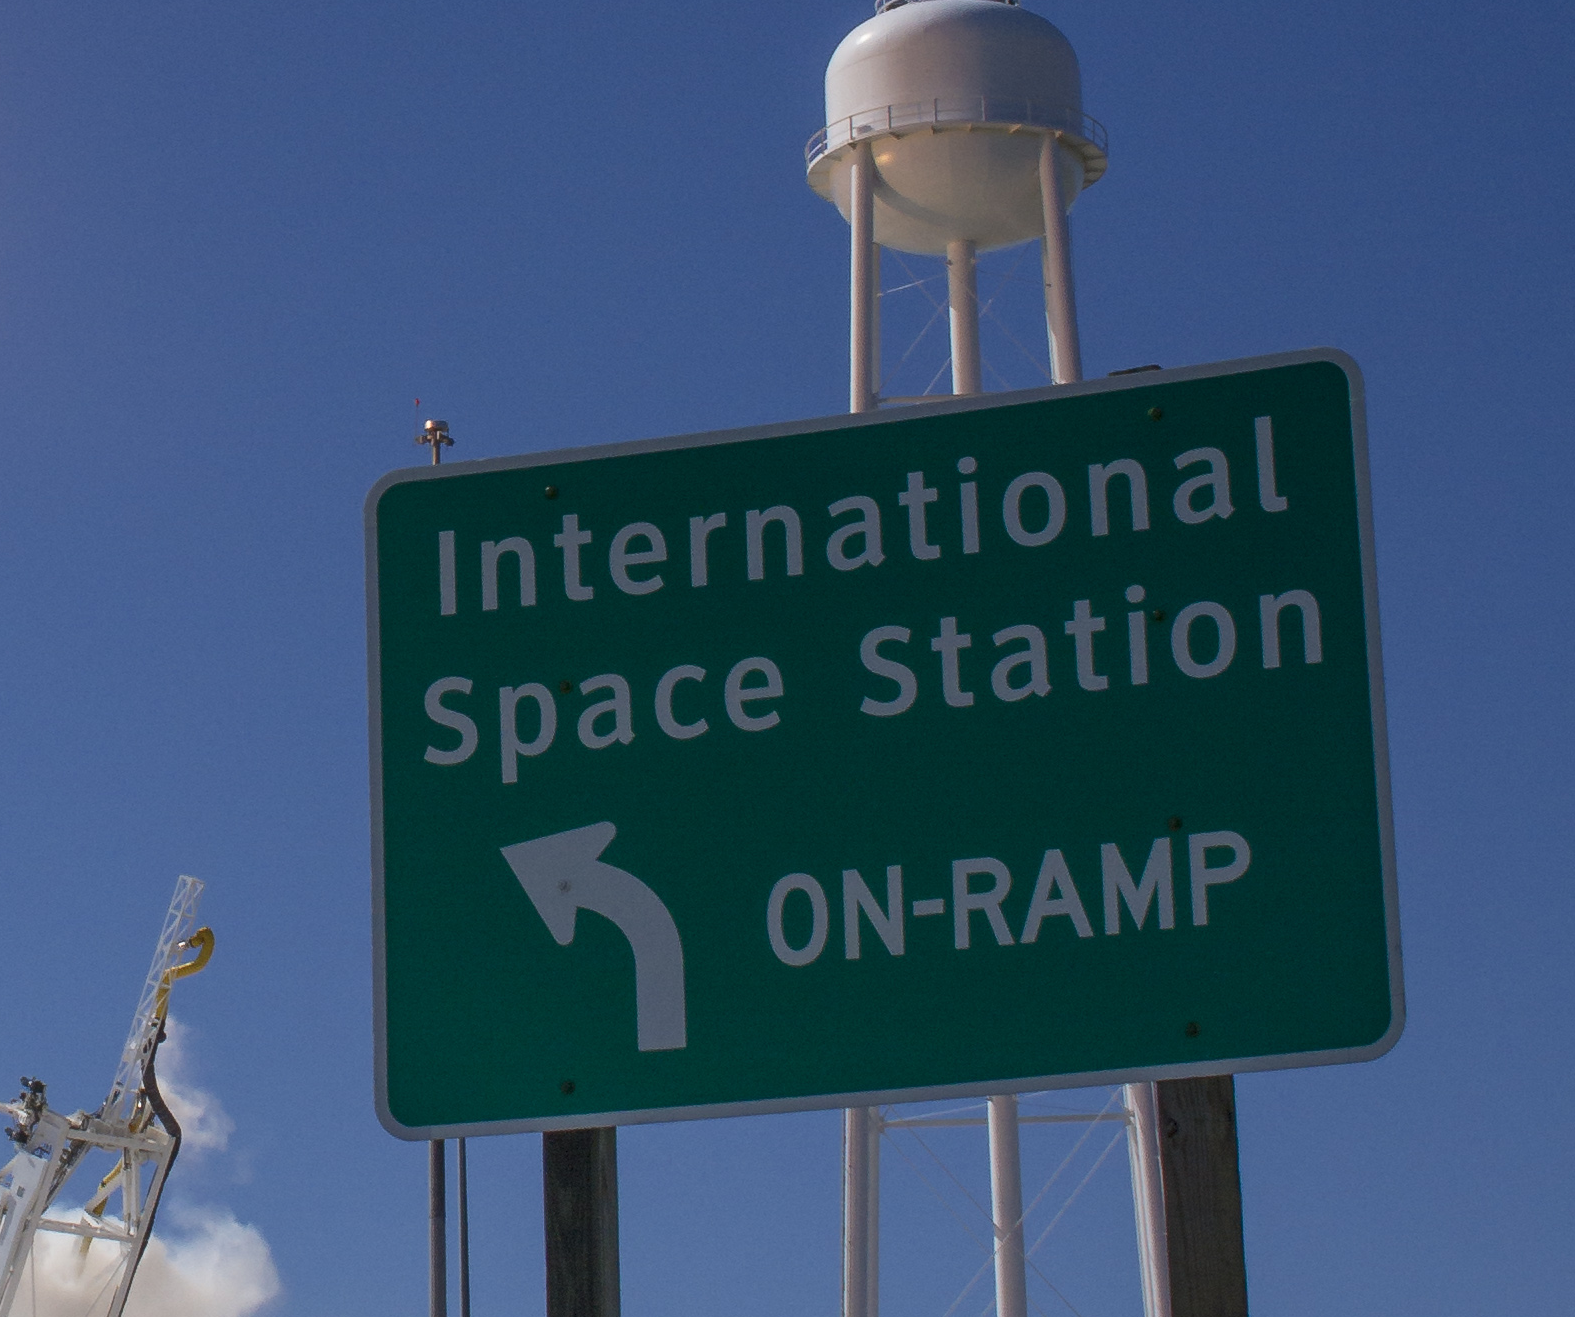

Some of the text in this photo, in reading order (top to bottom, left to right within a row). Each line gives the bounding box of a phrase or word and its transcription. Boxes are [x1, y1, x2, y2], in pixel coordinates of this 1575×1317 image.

[439, 416, 1288, 616] International
[425, 587, 1323, 785] Space Station
[767, 830, 1251, 967] ON-RAMP
